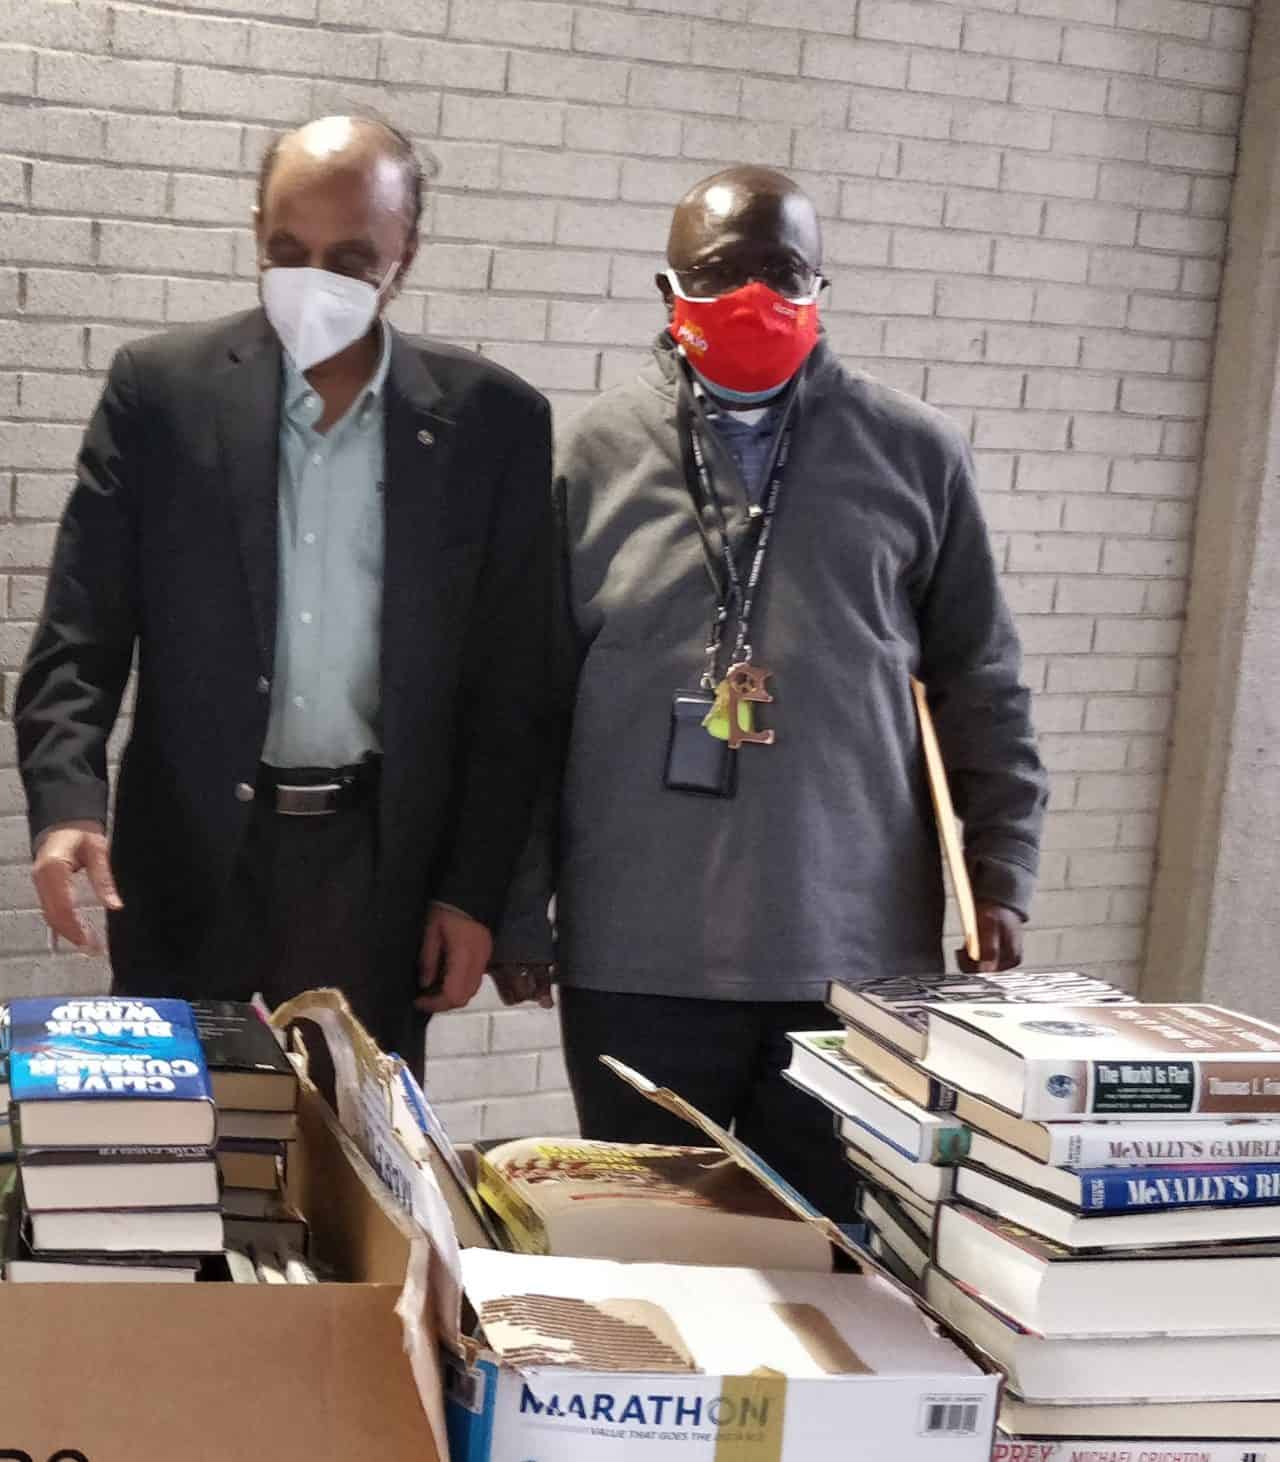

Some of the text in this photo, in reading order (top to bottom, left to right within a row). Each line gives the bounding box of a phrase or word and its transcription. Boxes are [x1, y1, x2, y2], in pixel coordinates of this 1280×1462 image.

[51, 1005, 163, 1021] WIND
[45, 1021, 173, 1037] BLACK
[29, 1058, 199, 1076] CUSSLER
[1098, 1065, 1119, 1083] The
[1120, 1065, 1153, 1083] World
[57, 1076, 176, 1093] CLIVE
[1127, 1175, 1249, 1205] McNALLY'S
[519, 1382, 769, 1427] MARATHON
[630, 1430, 656, 1440] THAT
[658, 1431, 688, 1441] GOES
[691, 1432, 712, 1442] THE
